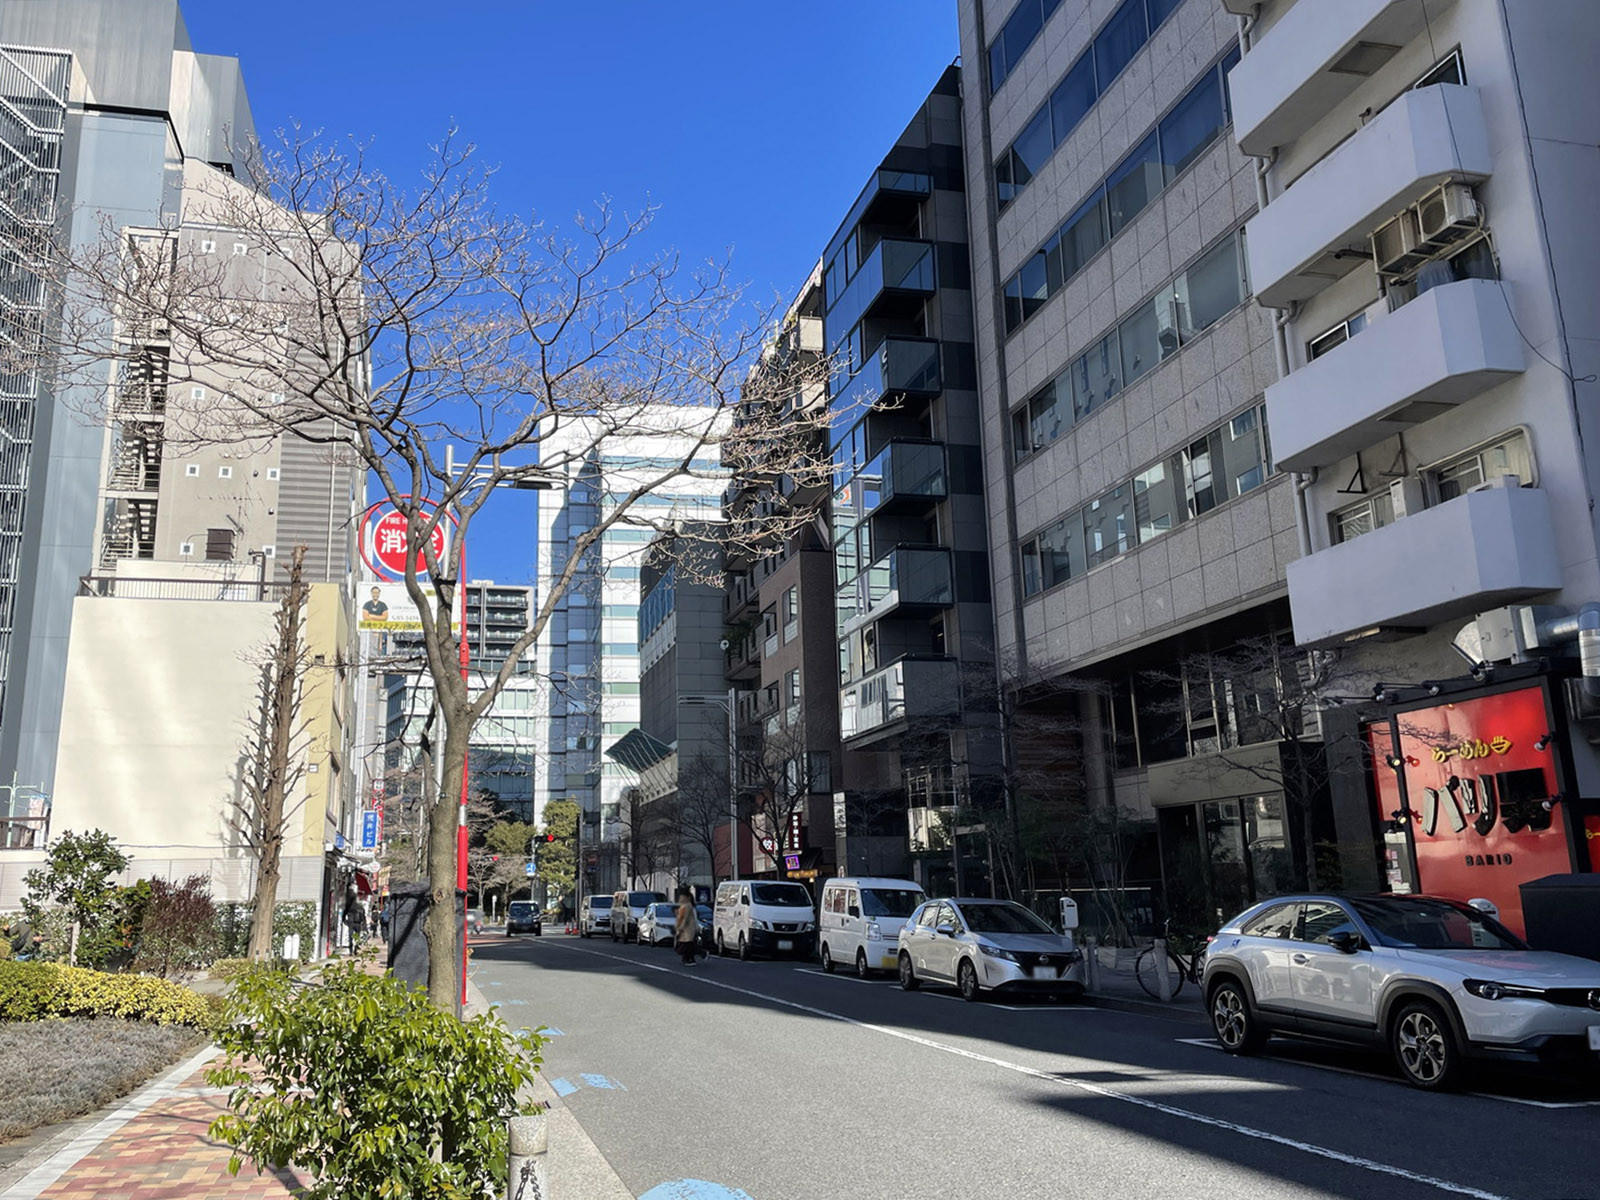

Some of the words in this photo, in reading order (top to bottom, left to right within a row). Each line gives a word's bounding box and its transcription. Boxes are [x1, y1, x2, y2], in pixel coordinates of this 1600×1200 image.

[385, 517, 401, 525] FIRE
[1431, 738, 1490, 763] らーめん
[1465, 854, 1513, 867] BARIO
